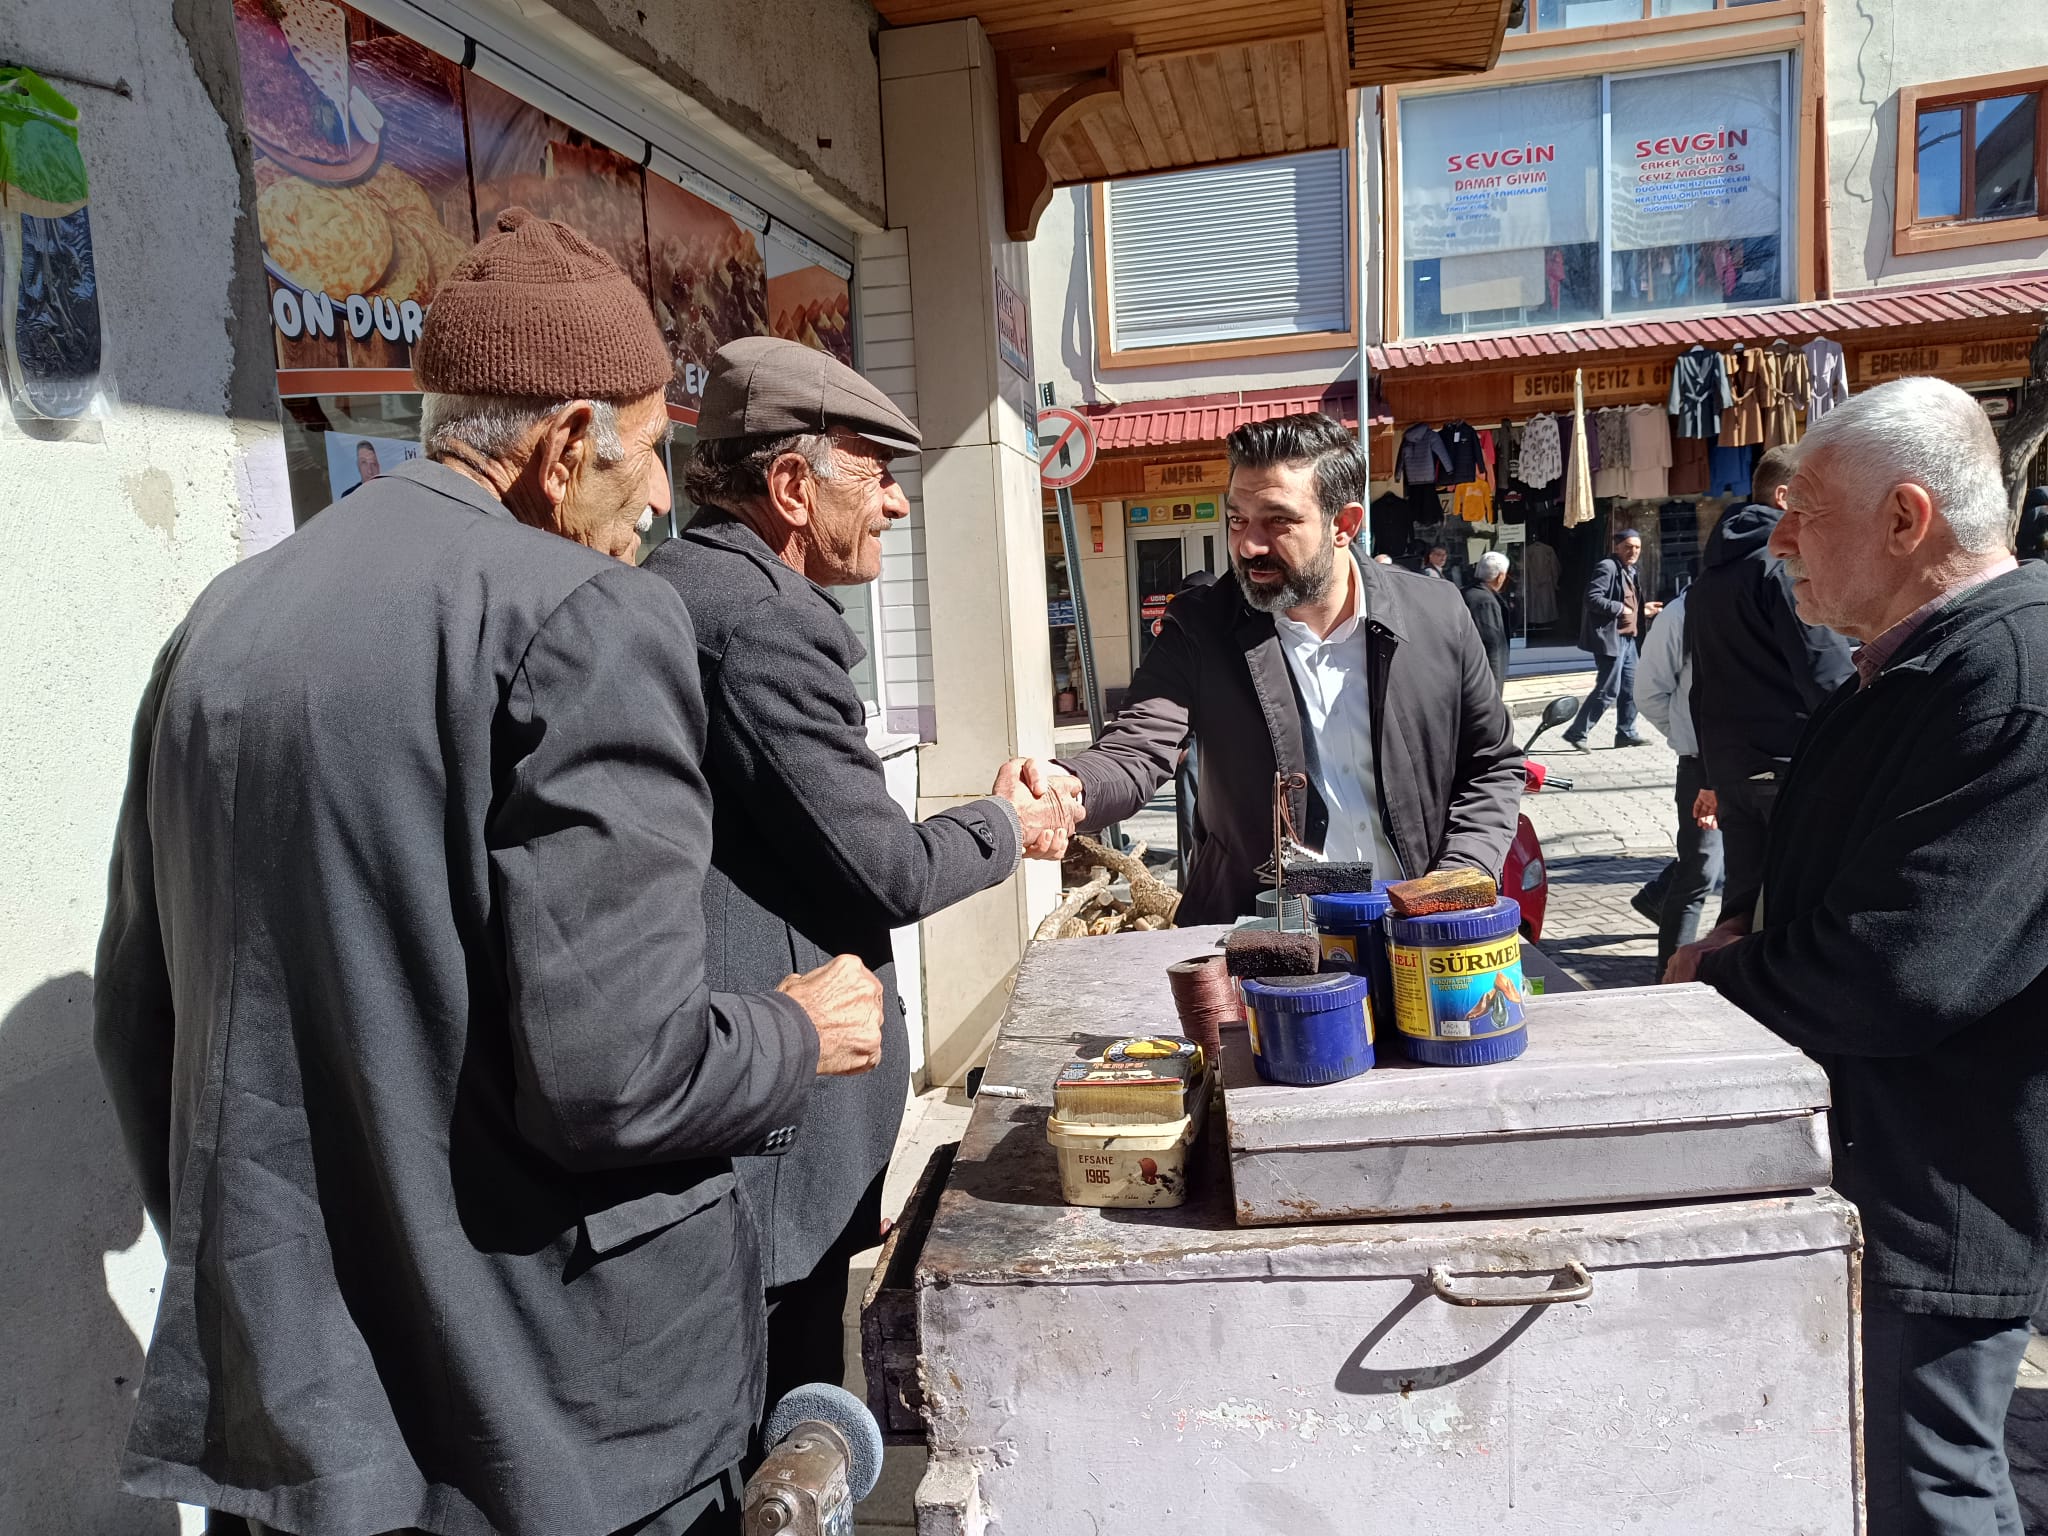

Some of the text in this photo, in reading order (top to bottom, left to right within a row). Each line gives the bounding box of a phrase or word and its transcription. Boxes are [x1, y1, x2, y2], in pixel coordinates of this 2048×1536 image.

[1636, 126, 1748, 158] SEVGİN
[1447, 142, 1555, 173] SEVGİN
[1640, 152, 1738, 171] ERKEK GİYİM &
[1455, 170, 1547, 192] DAMAT GİYİM
[1455, 192, 1492, 203] DAMAT
[269, 288, 424, 344] ON DUR
[1587, 366, 1630, 394] ÇEYİZ
[1637, 369, 1645, 386] &
[1160, 465, 1203, 486] AMPER
[1078, 1154, 1114, 1166] EFSANE
[1085, 1169, 1111, 1185] 1985
